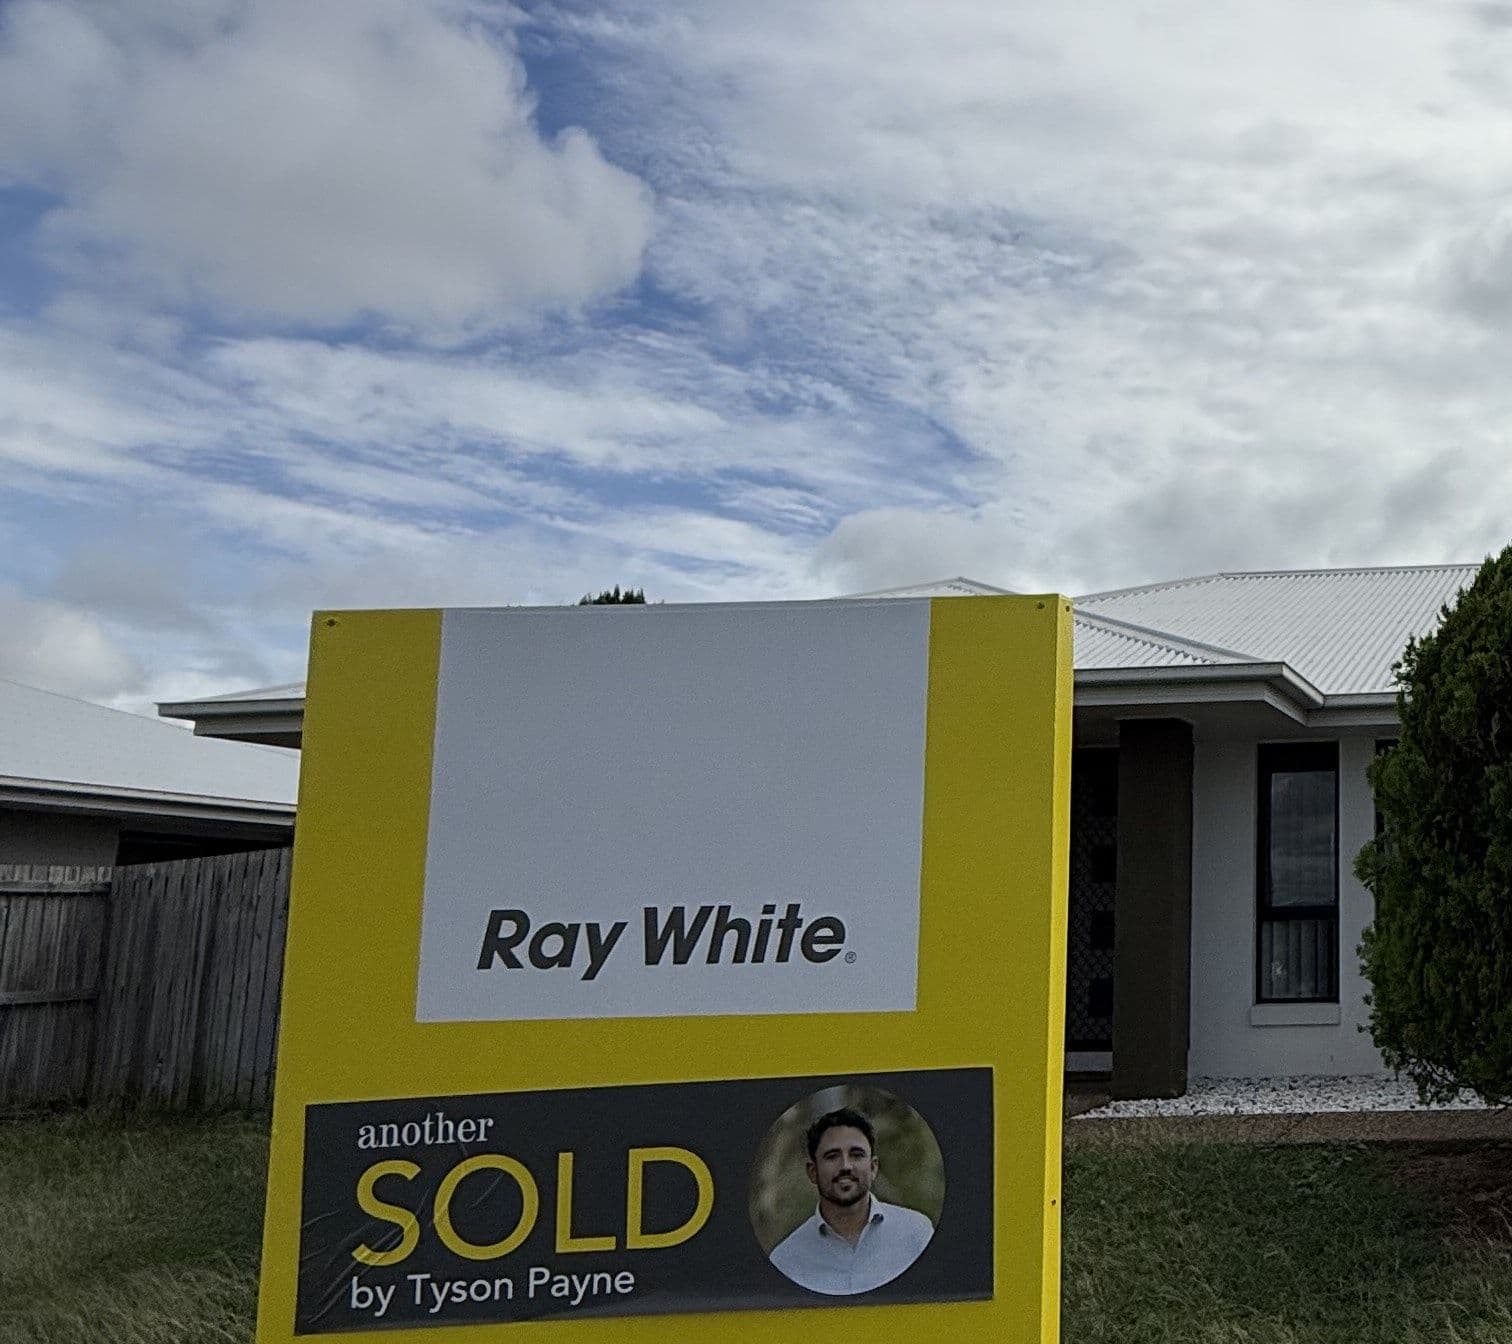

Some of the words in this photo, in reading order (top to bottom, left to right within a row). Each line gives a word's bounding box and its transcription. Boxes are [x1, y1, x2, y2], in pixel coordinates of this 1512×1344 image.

[477, 908, 628, 981] Ray
[643, 903, 847, 966] White
[357, 1112, 494, 1149] another
[352, 1146, 715, 1267] SOLD
[350, 1278, 396, 1317] by
[408, 1272, 515, 1312] Tyson
[529, 1267, 635, 1305] Payne
